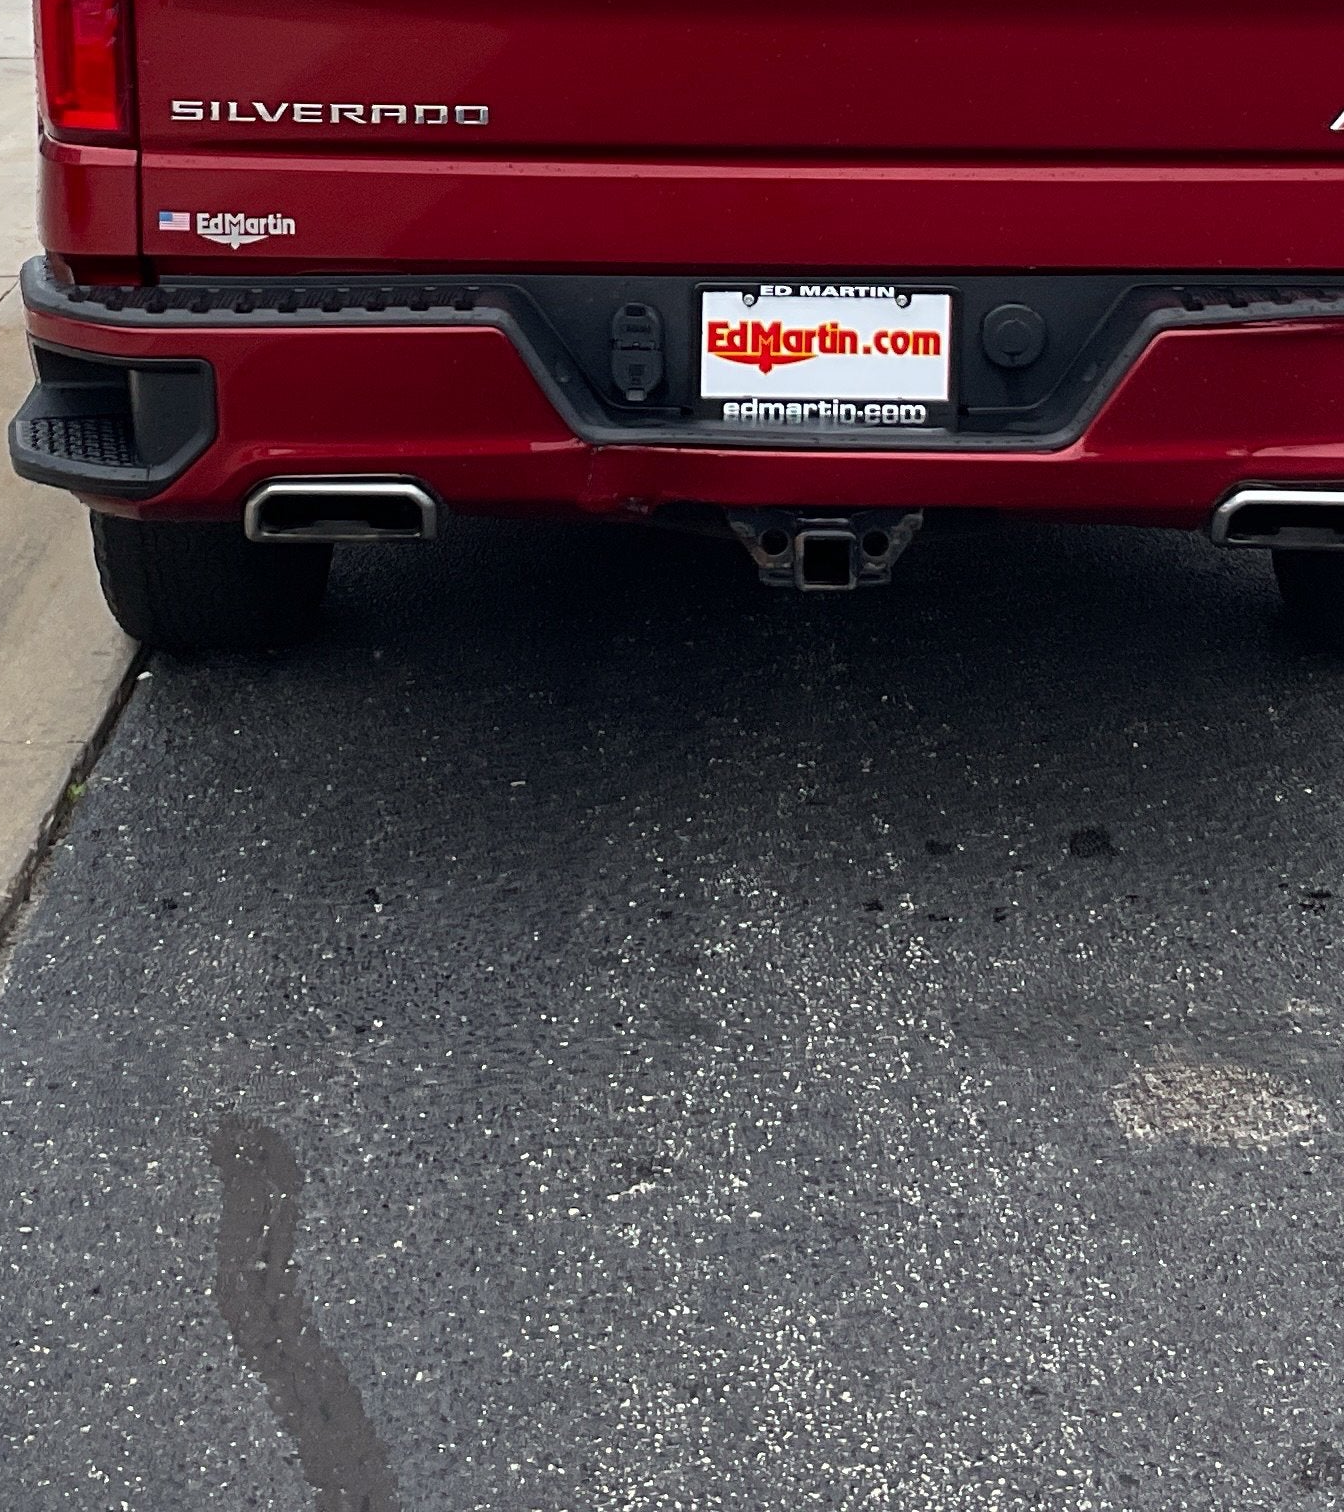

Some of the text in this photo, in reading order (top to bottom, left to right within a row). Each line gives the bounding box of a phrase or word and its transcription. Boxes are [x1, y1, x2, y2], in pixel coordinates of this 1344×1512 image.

[170, 100, 489, 125] SILVERADO
[196, 212, 296, 247] EdMartin
[759, 285, 895, 298] ED MARTIN
[707, 320, 941, 369] EdMartin.com
[723, 398, 926, 418] edmartin.com
